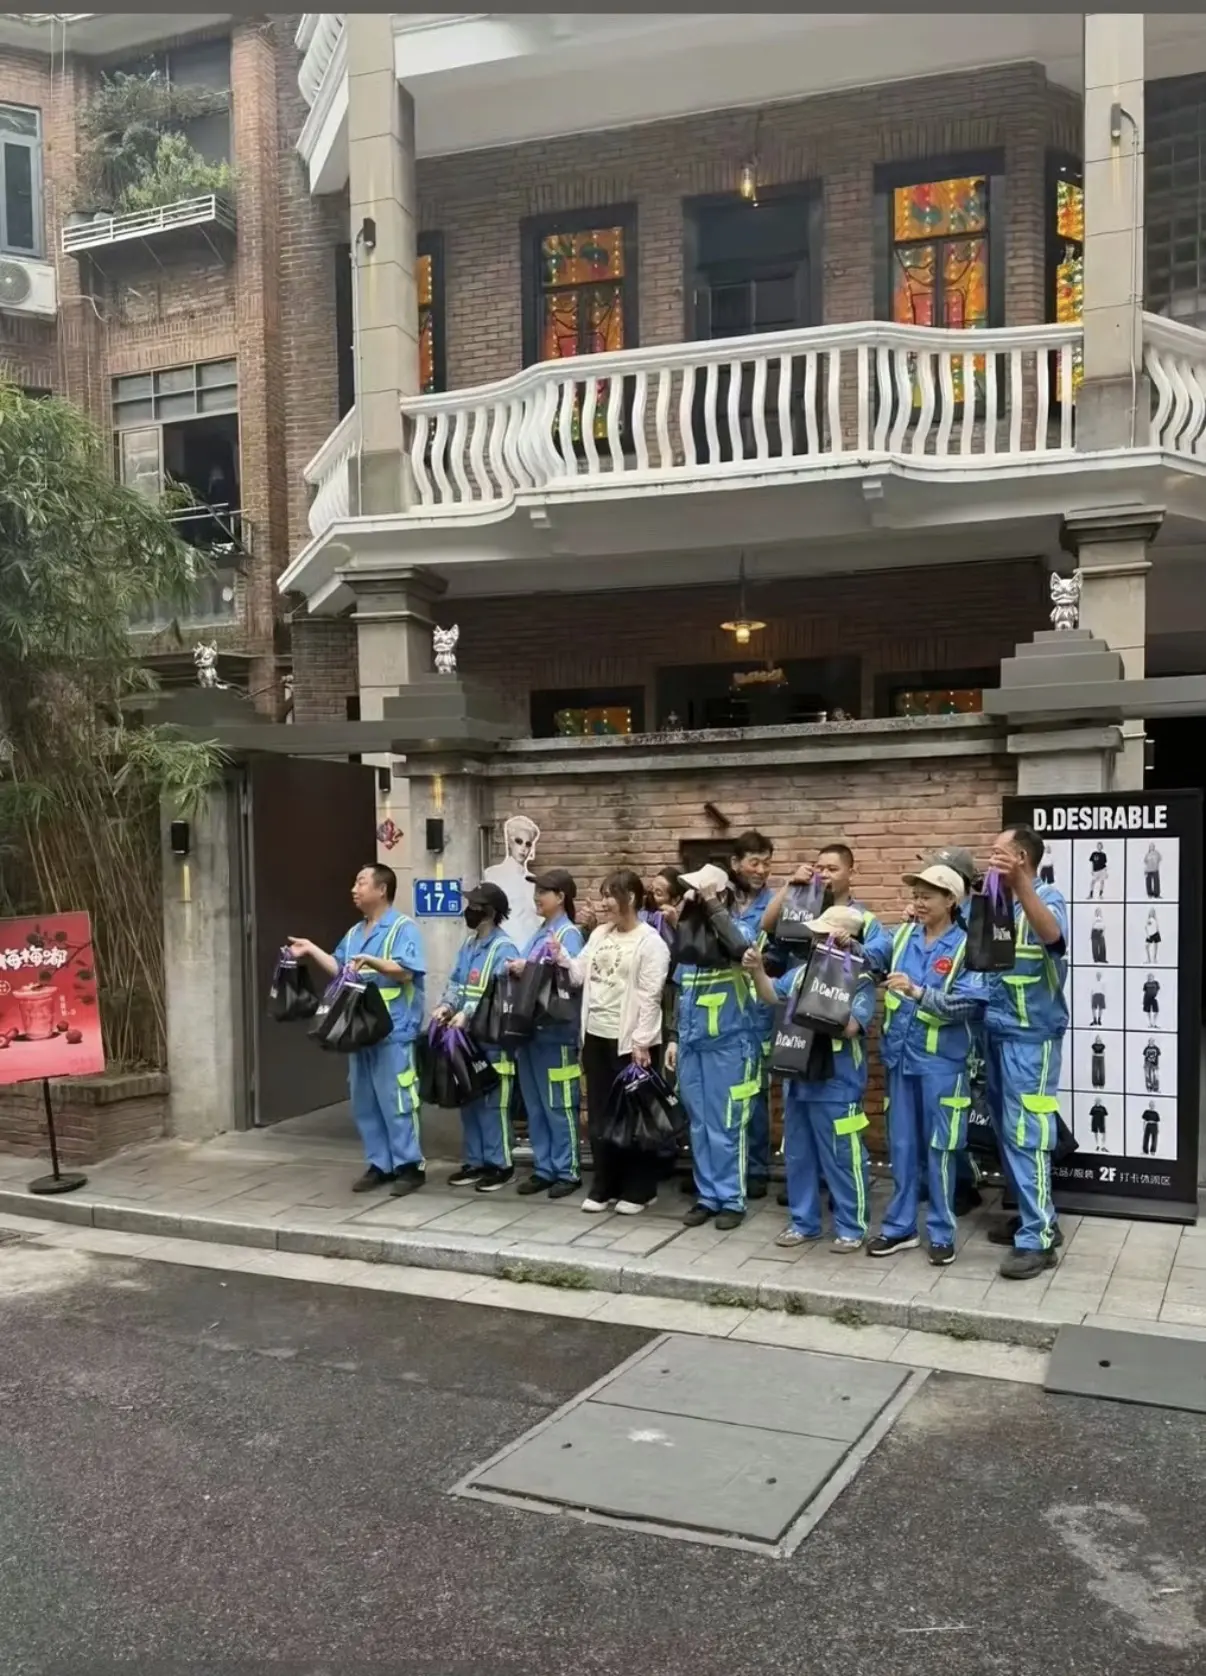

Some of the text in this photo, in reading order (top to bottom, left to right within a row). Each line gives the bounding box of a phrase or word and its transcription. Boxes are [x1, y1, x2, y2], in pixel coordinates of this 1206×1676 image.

[1033, 804, 1168, 831] D.DESIRABLE
[423, 892, 445, 912] 17
[1099, 1166, 1118, 1182] 2F
